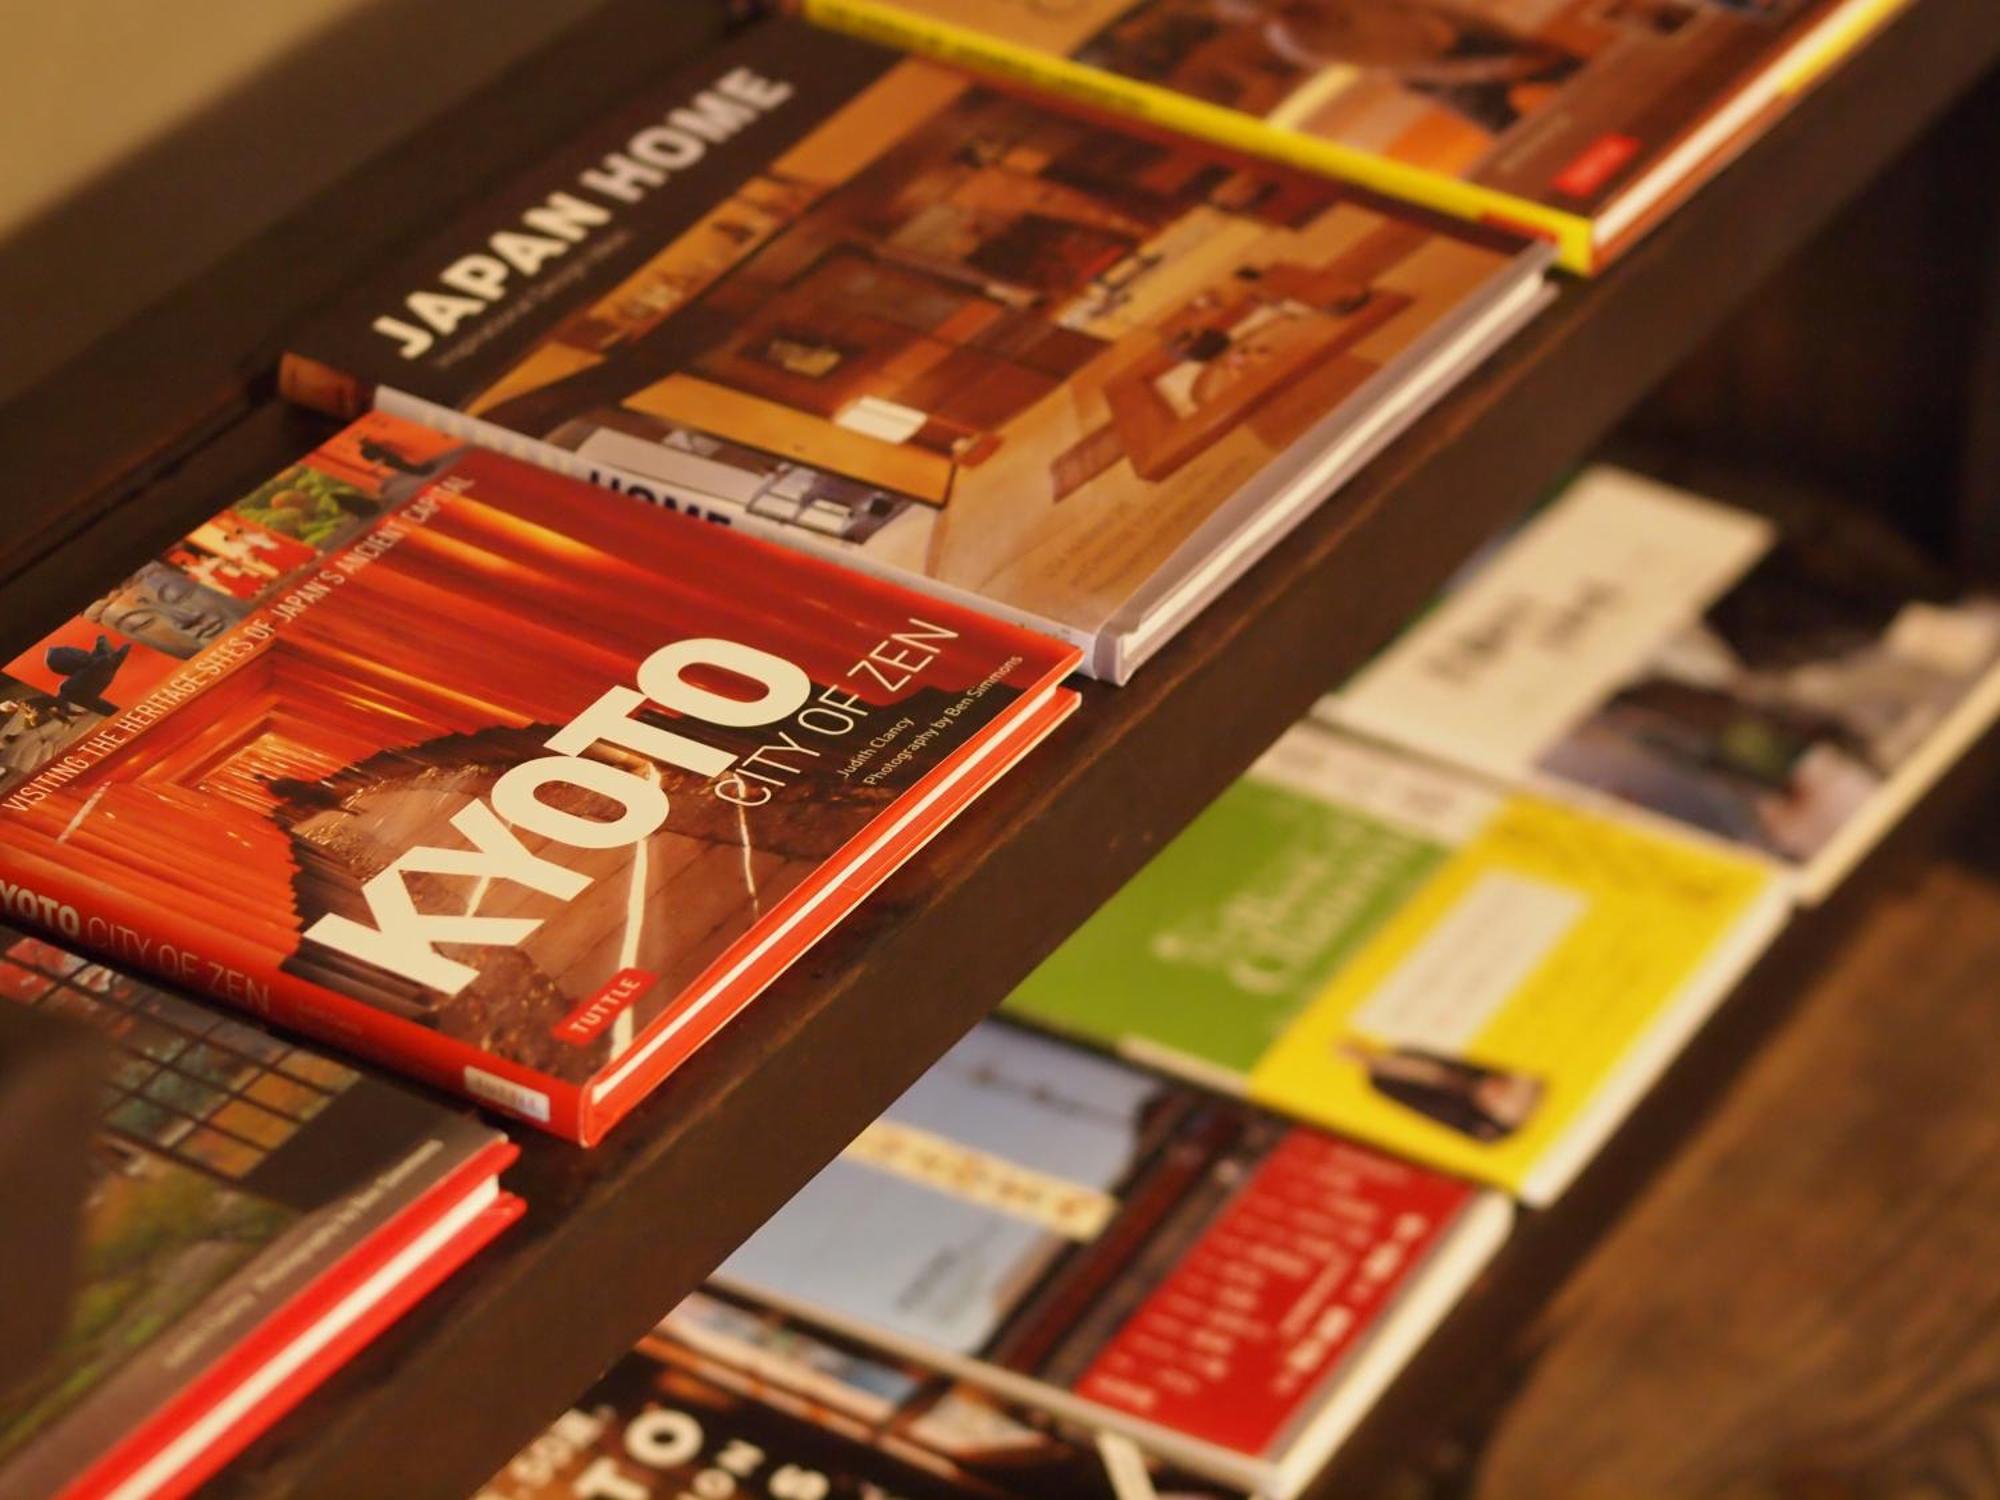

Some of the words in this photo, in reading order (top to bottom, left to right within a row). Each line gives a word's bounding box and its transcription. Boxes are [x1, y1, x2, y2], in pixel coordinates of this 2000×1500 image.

[371, 191, 612, 361] JAPAN
[579, 66, 794, 203] HOME
[2, 755, 90, 812] VISITING
[78, 730, 127, 757] THE
[115, 673, 208, 733] HERITAGE
[195, 637, 255, 675] SITES
[243, 618, 276, 640] OF
[270, 570, 346, 622] JAPAN'S
[335, 519, 411, 575] ANCIENT
[401, 475, 476, 523] CAPITAL
[714, 731, 821, 807] CITY
[797, 684, 869, 737] OF
[846, 618, 959, 693] ZEN
[862, 728, 940, 786] Photography
[931, 715, 954, 736] by
[944, 696, 974, 718] Ben
[966, 656, 1024, 698] Simmons
[304, 638, 812, 996] KYOTO
[836, 745, 876, 779] Judith
[869, 716, 916, 748] Clancy
[87, 917, 152, 966] CITY
[159, 944, 199, 981] OF
[208, 960, 271, 1014] ZEN
[569, 977, 641, 1034] TUTTLE
